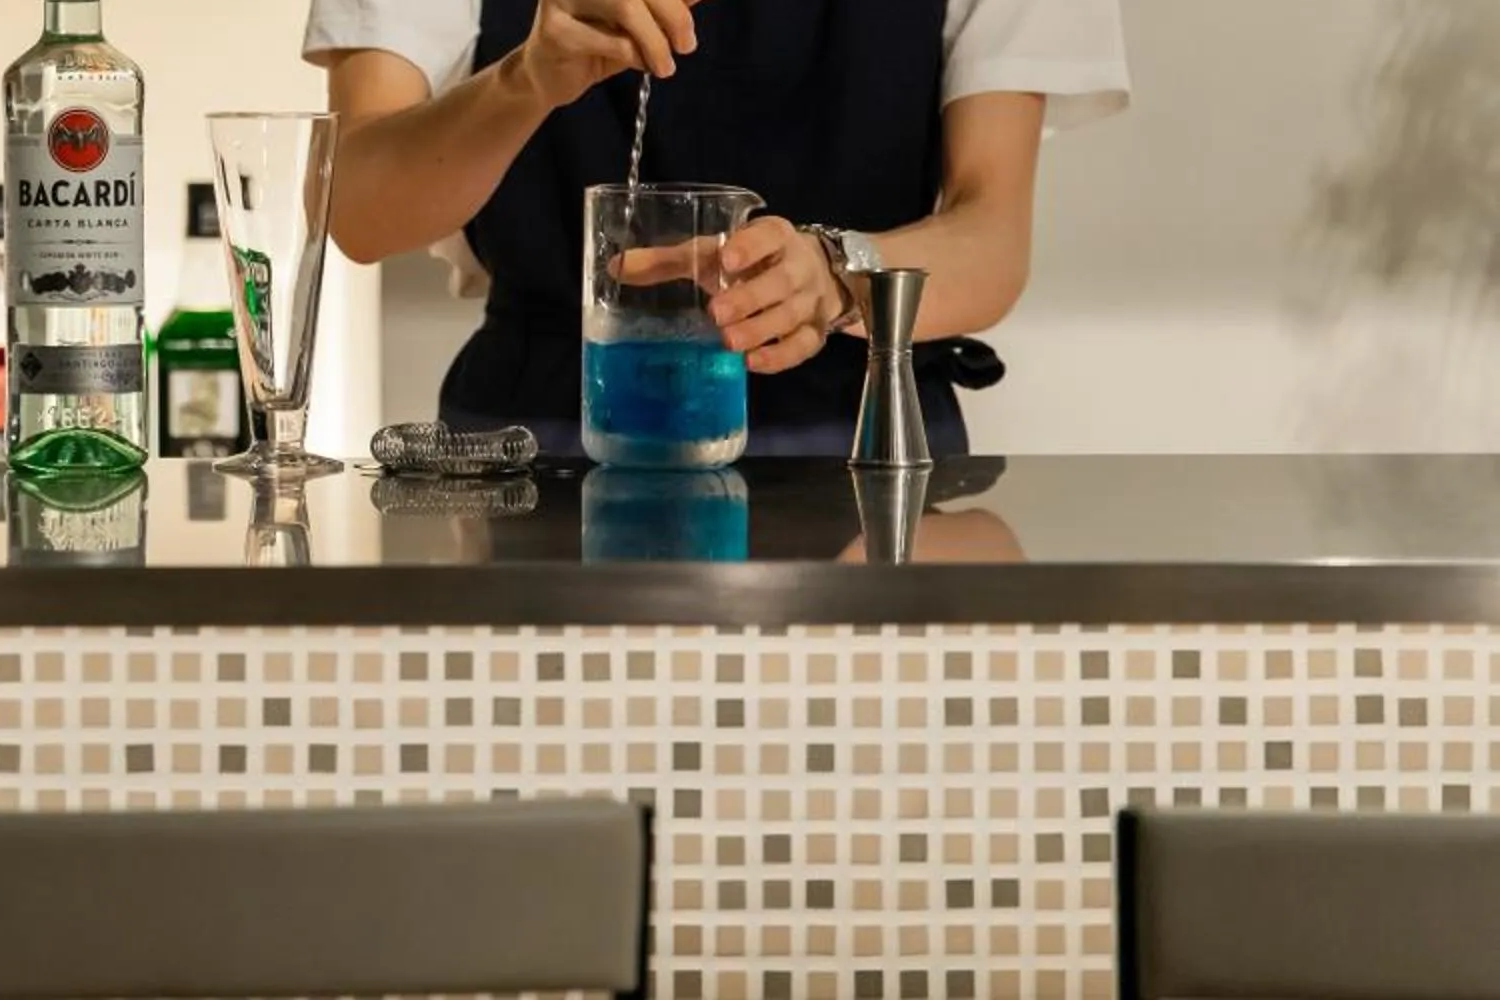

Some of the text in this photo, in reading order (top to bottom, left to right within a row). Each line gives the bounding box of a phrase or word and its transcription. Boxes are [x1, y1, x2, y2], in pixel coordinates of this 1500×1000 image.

[18, 171, 136, 208] BACARDÍ
[27, 218, 128, 229] CARTA BLANCA
